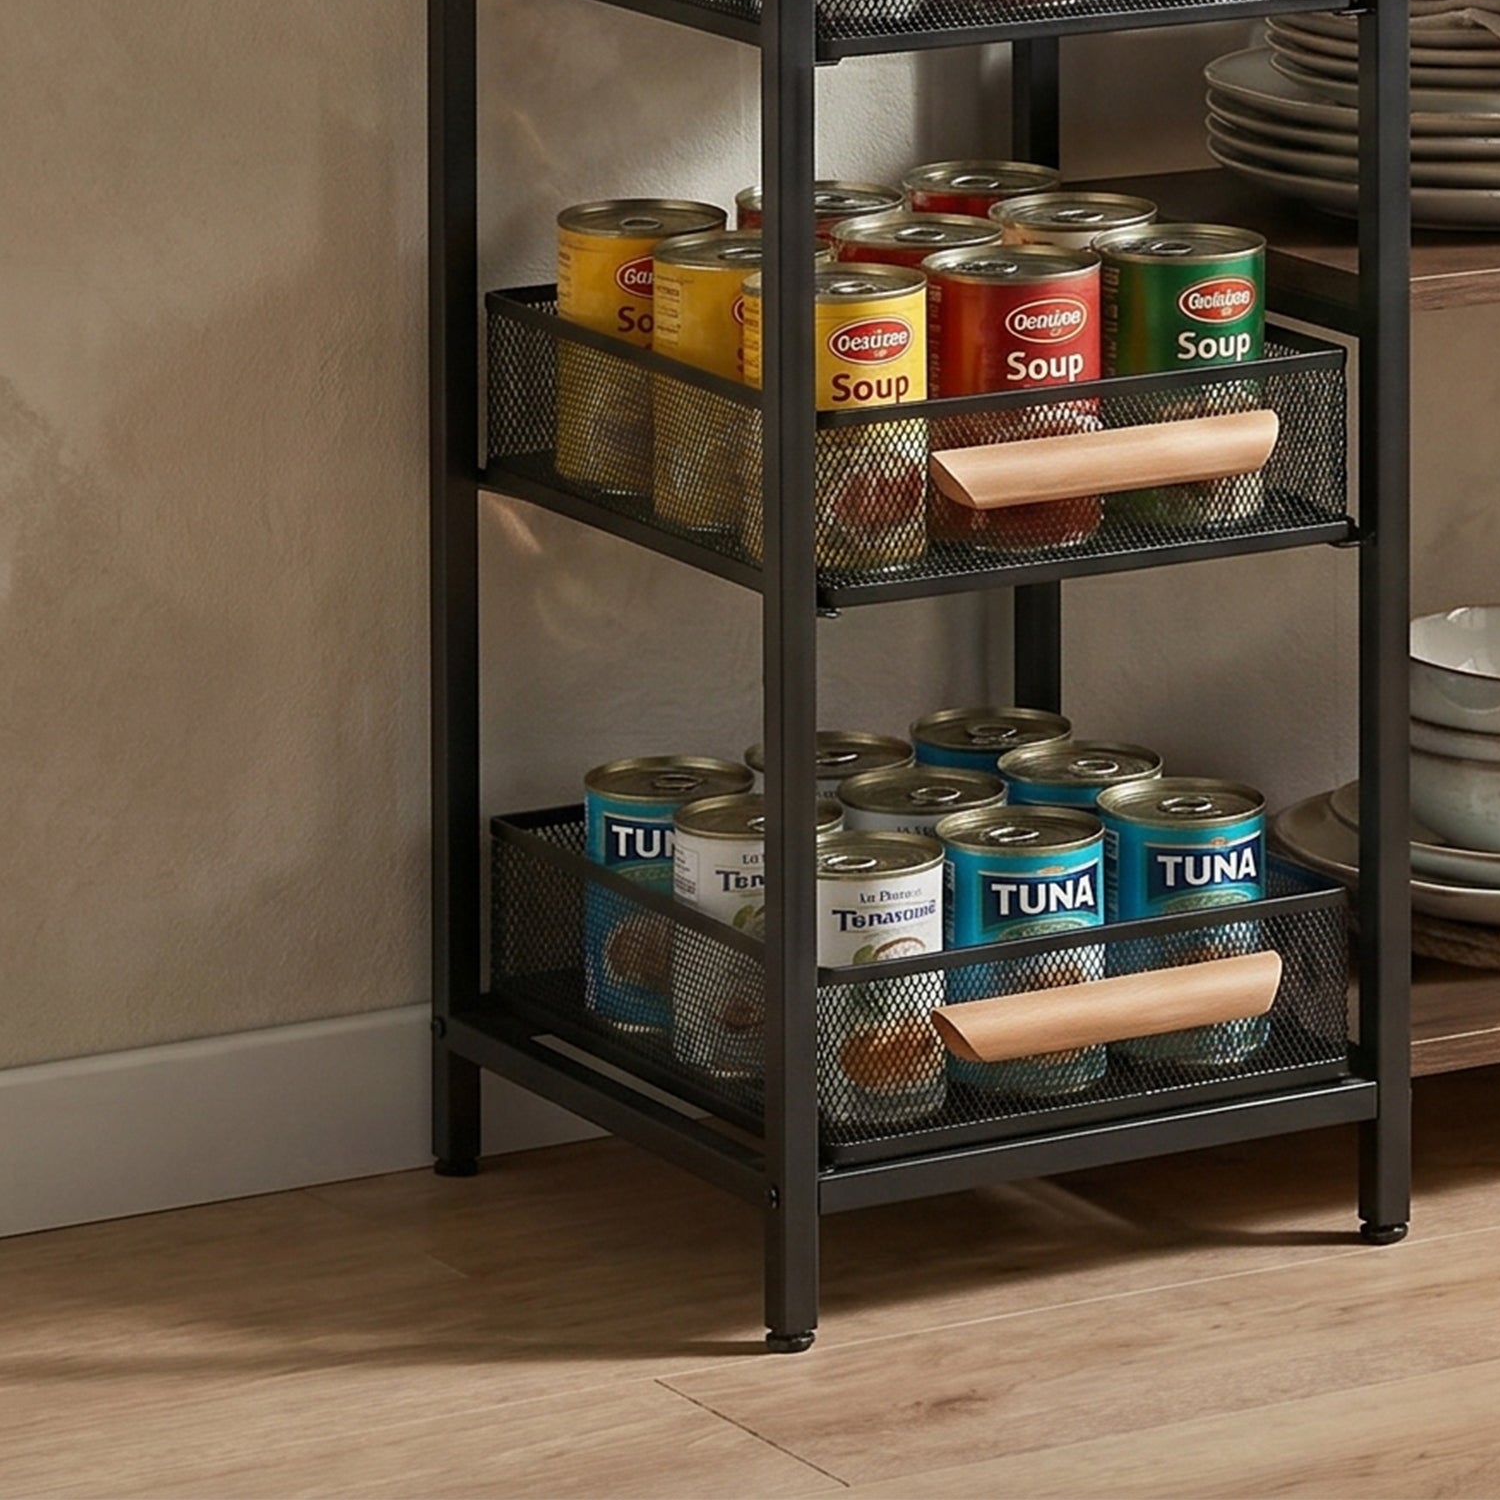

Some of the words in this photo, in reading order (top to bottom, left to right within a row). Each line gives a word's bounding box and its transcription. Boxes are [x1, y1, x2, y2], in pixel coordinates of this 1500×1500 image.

[1177, 331, 1251, 362] Soup
[1006, 351, 1084, 383] Soup
[831, 373, 909, 405] Soup
[1157, 847, 1257, 887] TUNA
[991, 874, 1096, 916] TUNA
